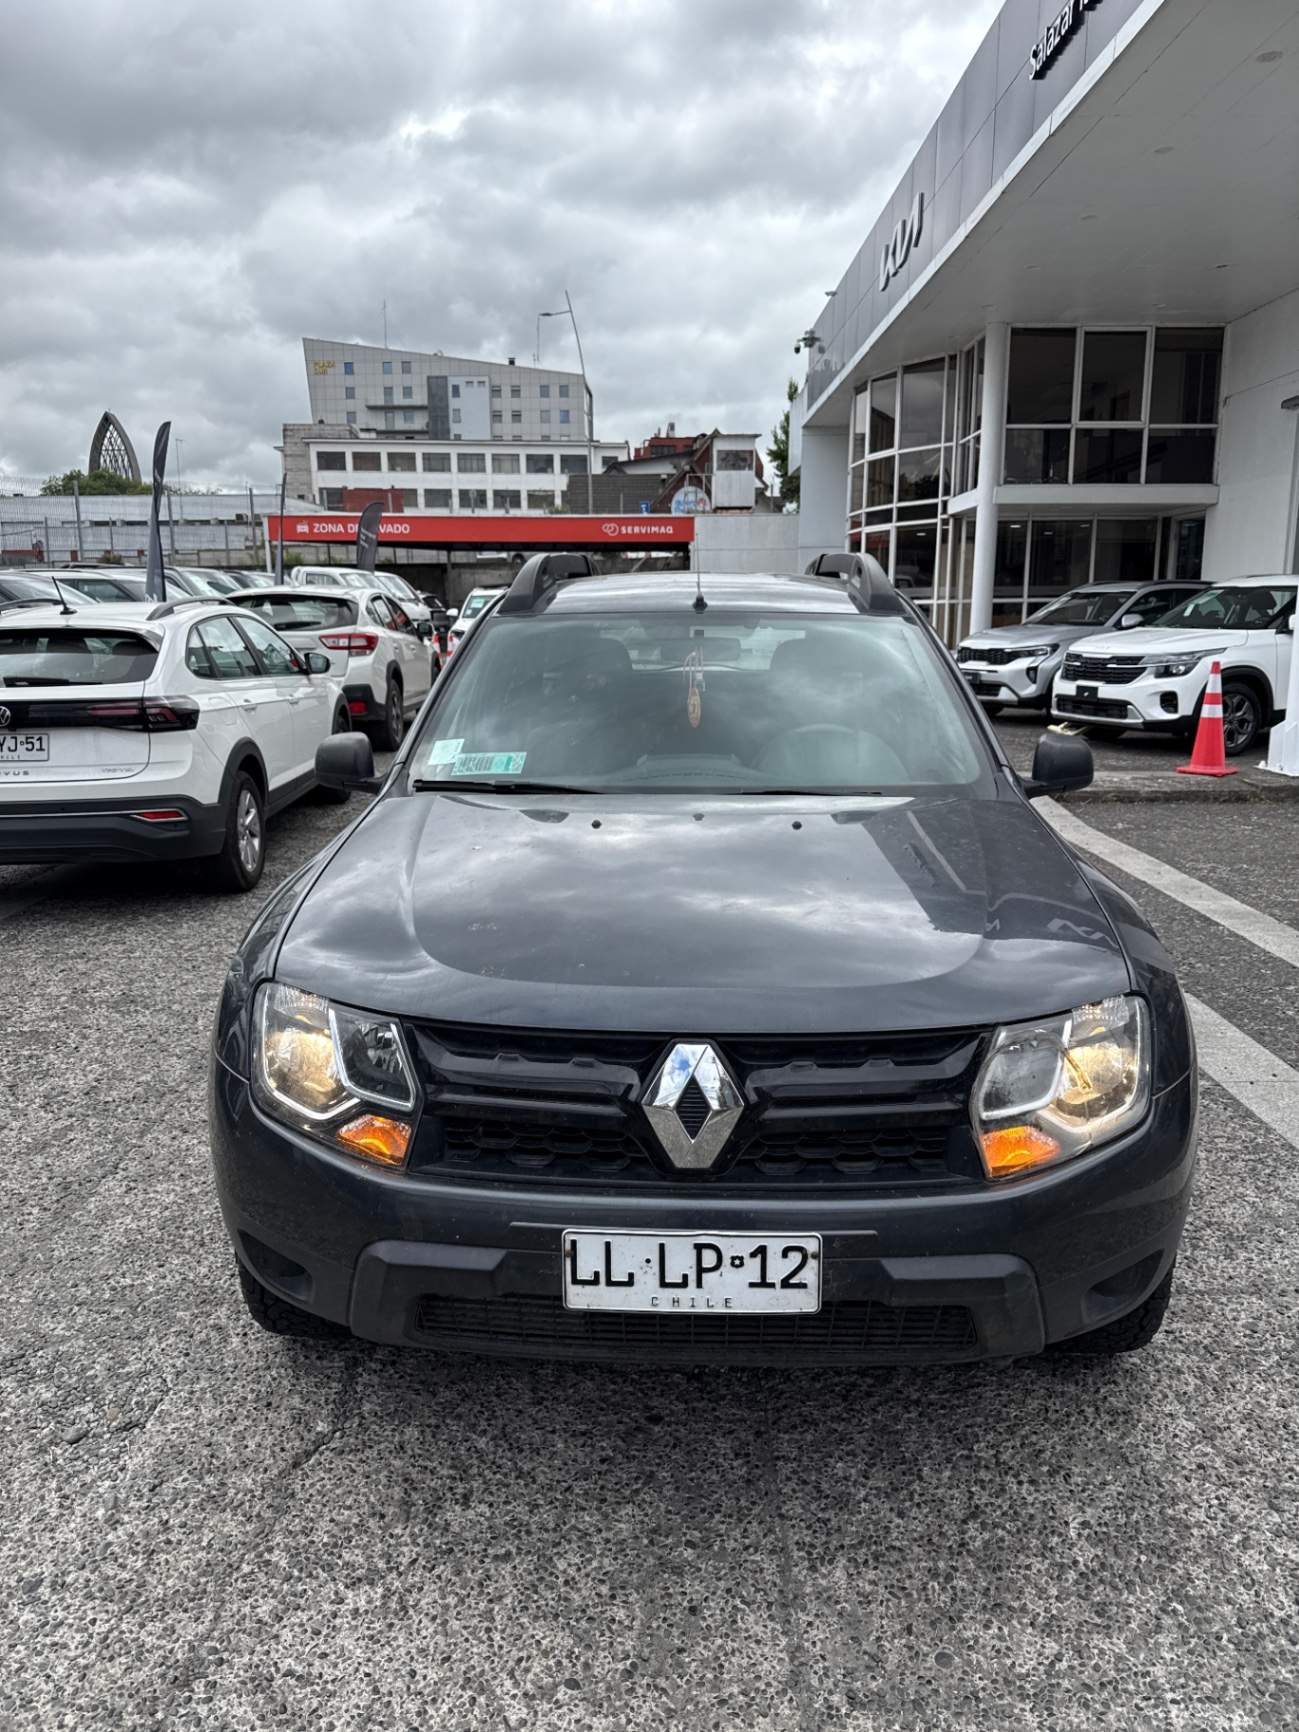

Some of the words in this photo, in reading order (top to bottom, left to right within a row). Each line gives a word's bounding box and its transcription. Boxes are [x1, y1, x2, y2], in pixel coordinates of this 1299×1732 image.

[313, 523, 345, 534] ZONA
[379, 524, 410, 534] VADO
[620, 525, 674, 535] SERVIMAQ
[650, 1296, 733, 1309] CHILE
